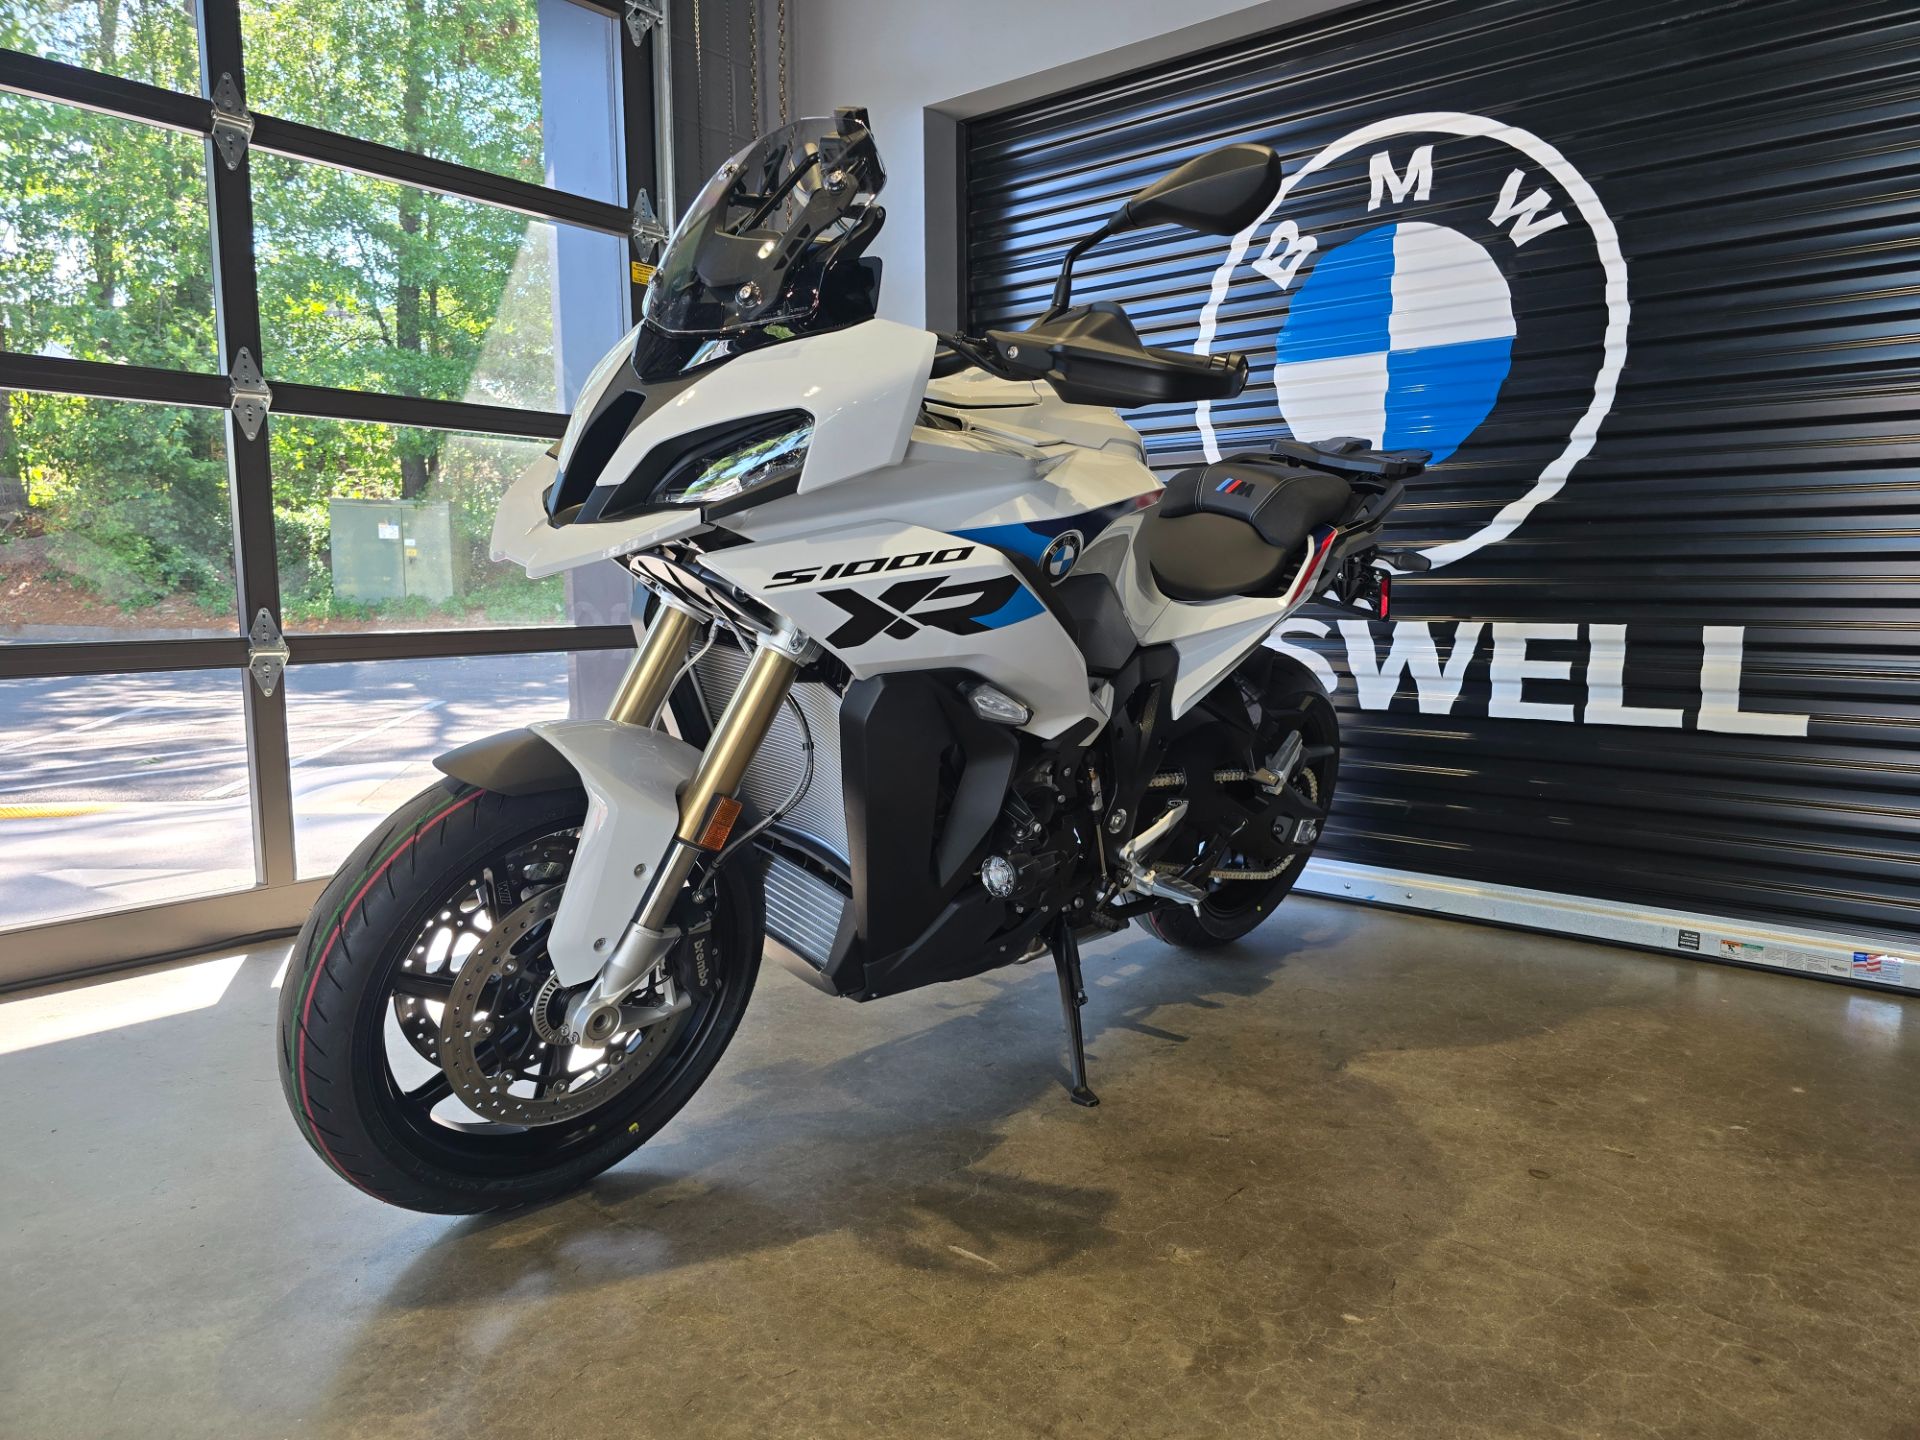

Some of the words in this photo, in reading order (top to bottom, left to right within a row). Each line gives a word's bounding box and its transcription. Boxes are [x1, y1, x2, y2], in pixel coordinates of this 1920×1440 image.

[1252, 145, 1569, 290] BMW
[763, 545, 976, 590] S1000
[816, 574, 1026, 650] XR
[694, 938, 709, 987] brembo
